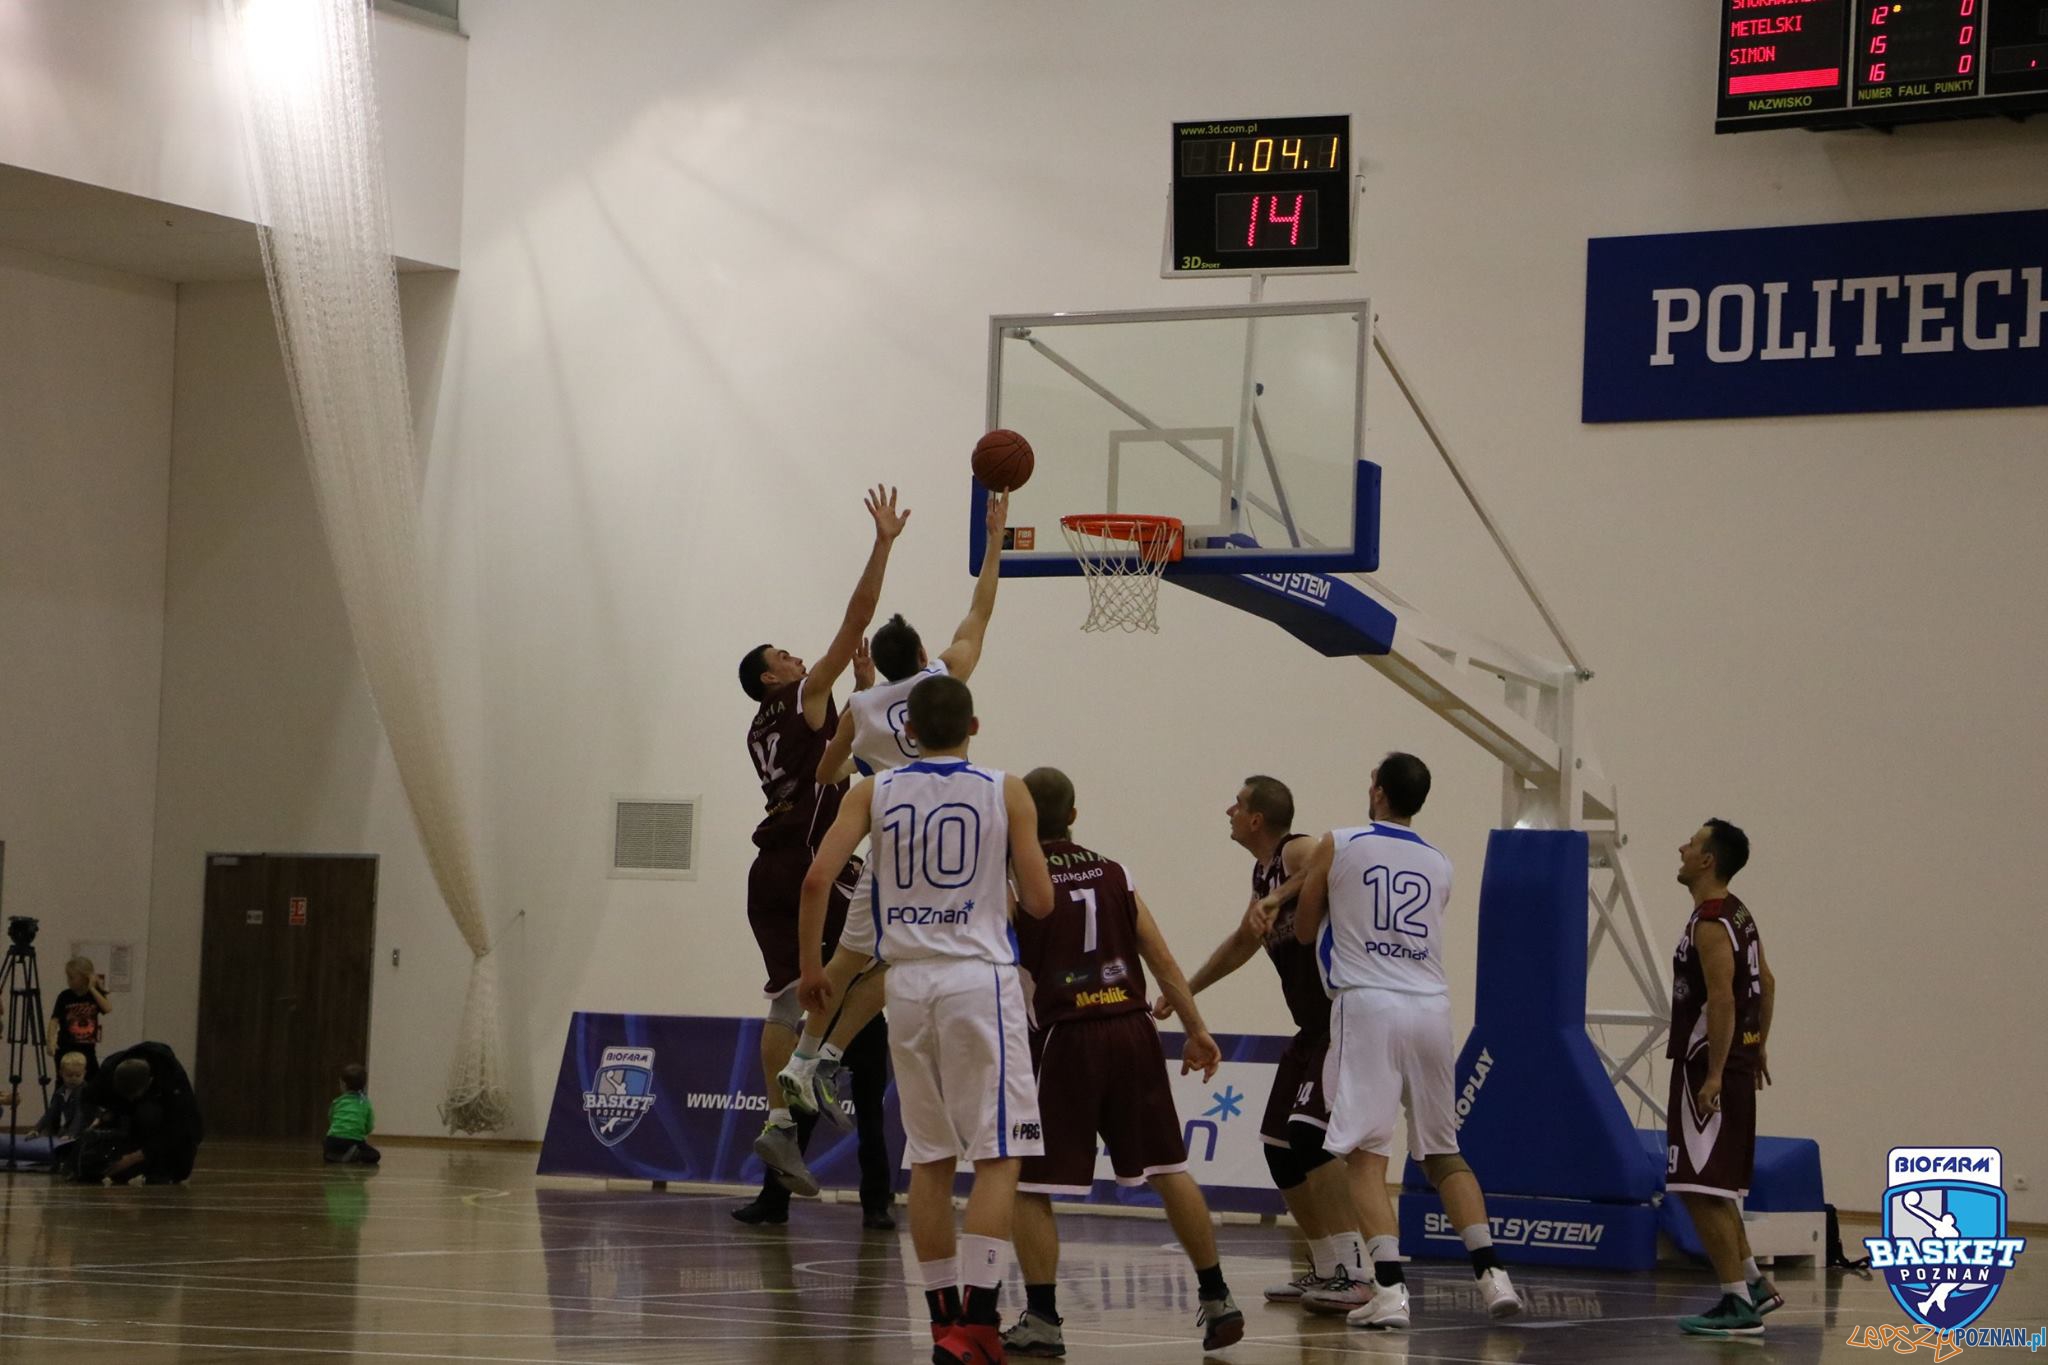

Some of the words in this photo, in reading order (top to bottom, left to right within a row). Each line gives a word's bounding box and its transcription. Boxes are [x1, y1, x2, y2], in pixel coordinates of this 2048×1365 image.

[1871, 6, 1889, 25] 12
[1731, 15, 1802, 37] METELSKI
[1959, 26, 1973, 45] 0
[1869, 35, 1887, 54] 15
[1730, 45, 1776, 65] SIMON
[1958, 54, 1972, 74] 0
[1868, 63, 1886, 82] 16
[1857, 87, 1893, 101] NUMER
[1898, 83, 1930, 97] FAUL
[1934, 79, 1975, 93] PUNKTY
[1748, 95, 1813, 111] NAZWISKO
[1180, 123, 1258, 136] www.3d.com.pl
[1247, 194, 1303, 247] 14
[1182, 256, 1202, 270] 3D
[882, 803, 980, 889] 10
[1363, 864, 1431, 938] 12
[1069, 887, 1098, 953] 7
[584, 1093, 655, 1112] BASKET
[1020, 1122, 1041, 1141] PBG
